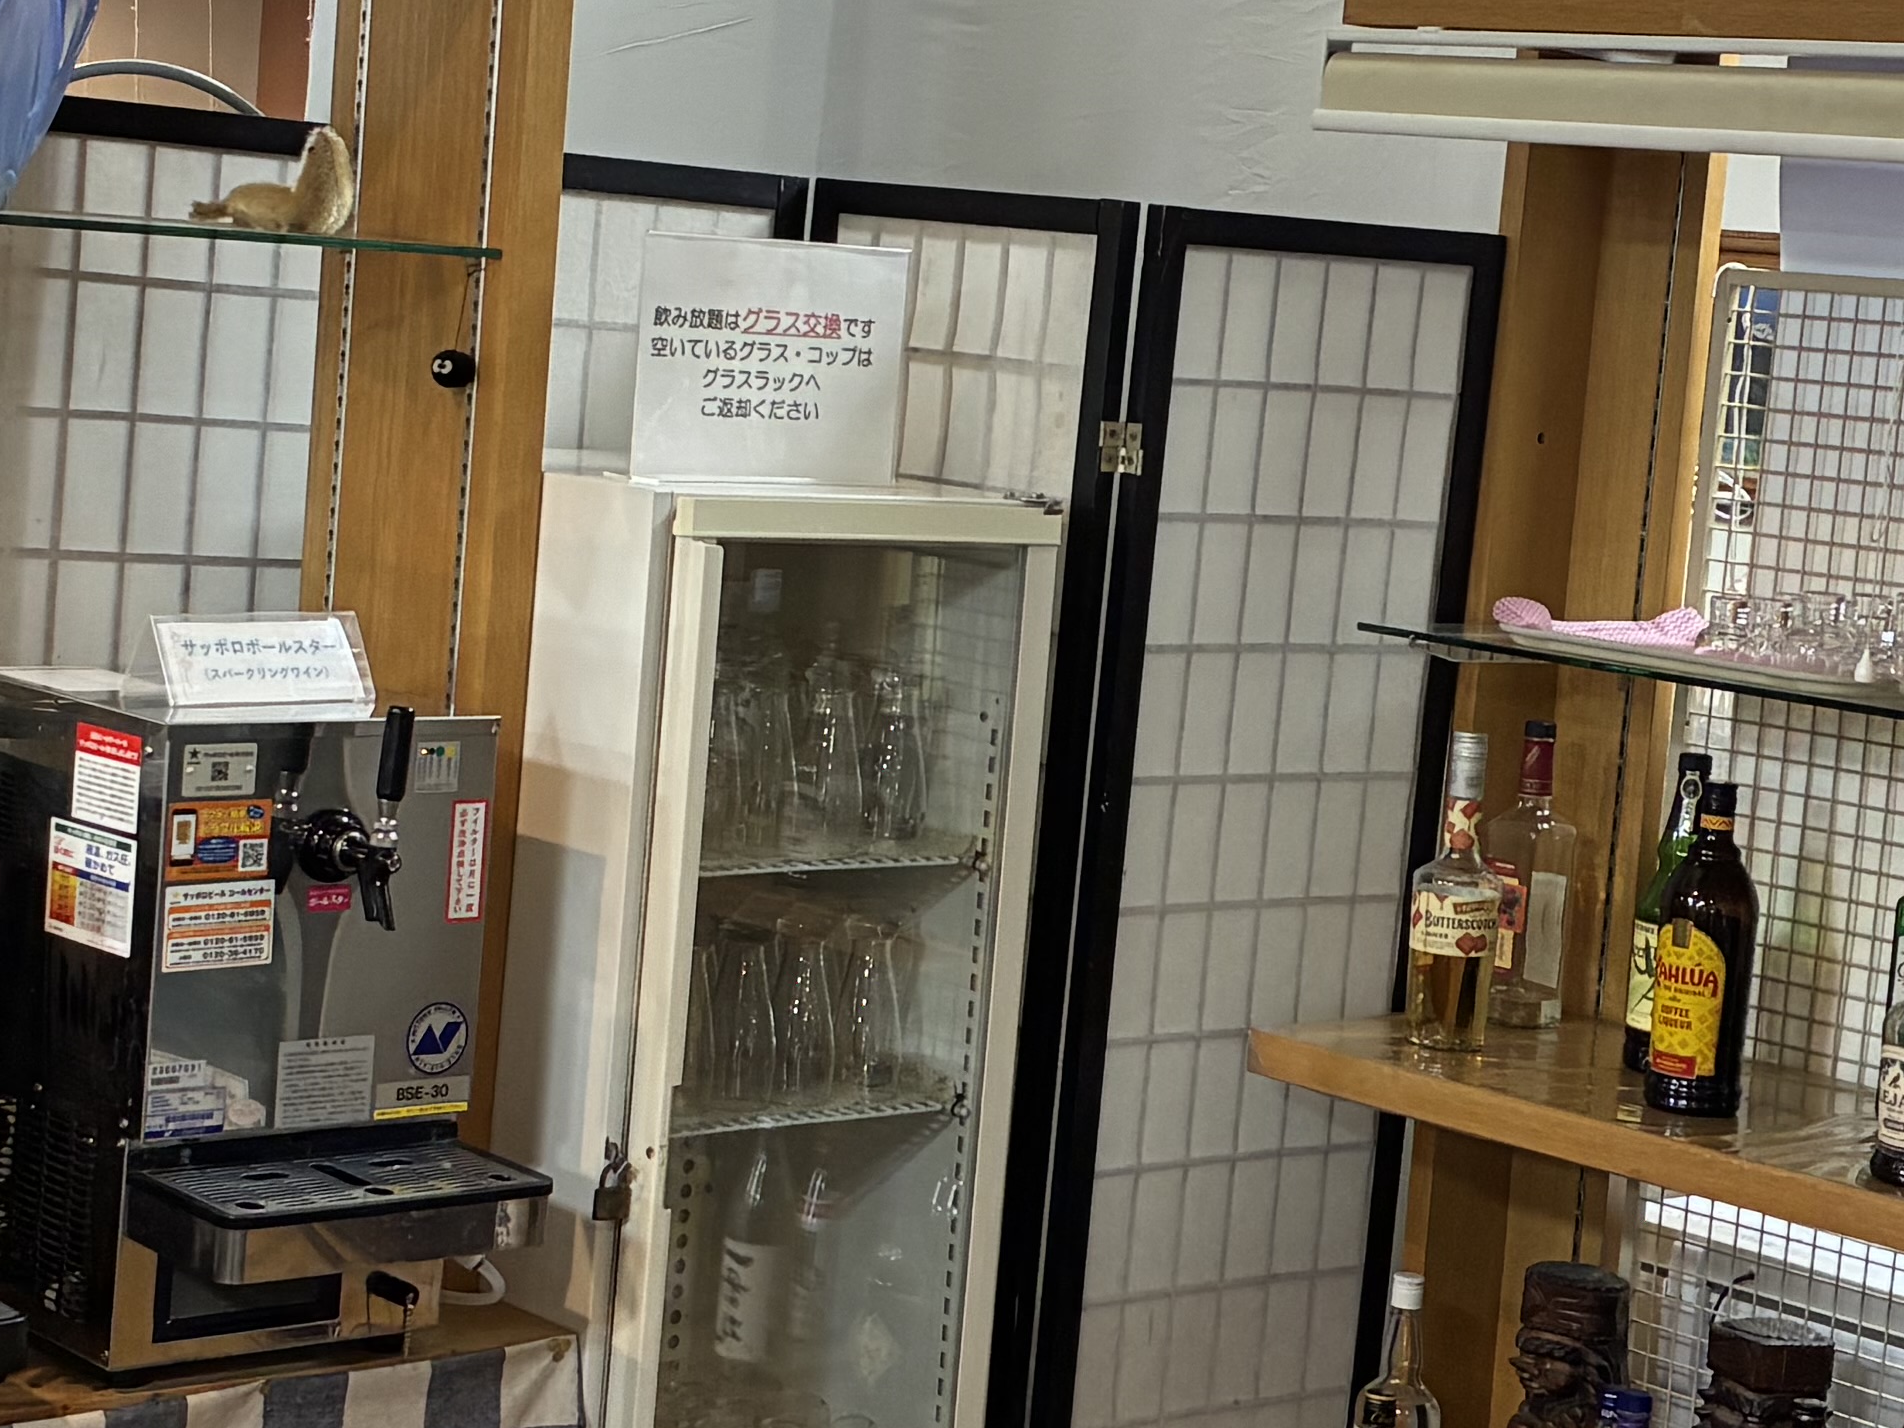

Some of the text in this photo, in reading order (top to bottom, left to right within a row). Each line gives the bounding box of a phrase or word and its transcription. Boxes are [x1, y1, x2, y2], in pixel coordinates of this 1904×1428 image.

[652, 304, 876, 340] 飲み放題はグラス交換です
[650, 336, 874, 368] 空いているグラス・コップは
[702, 367, 821, 392] グラスラックへ
[700, 396, 821, 421] ご返却ください
[180, 637, 337, 657] サッポロボールスター
[396, 1084, 449, 1102] BSE-30
